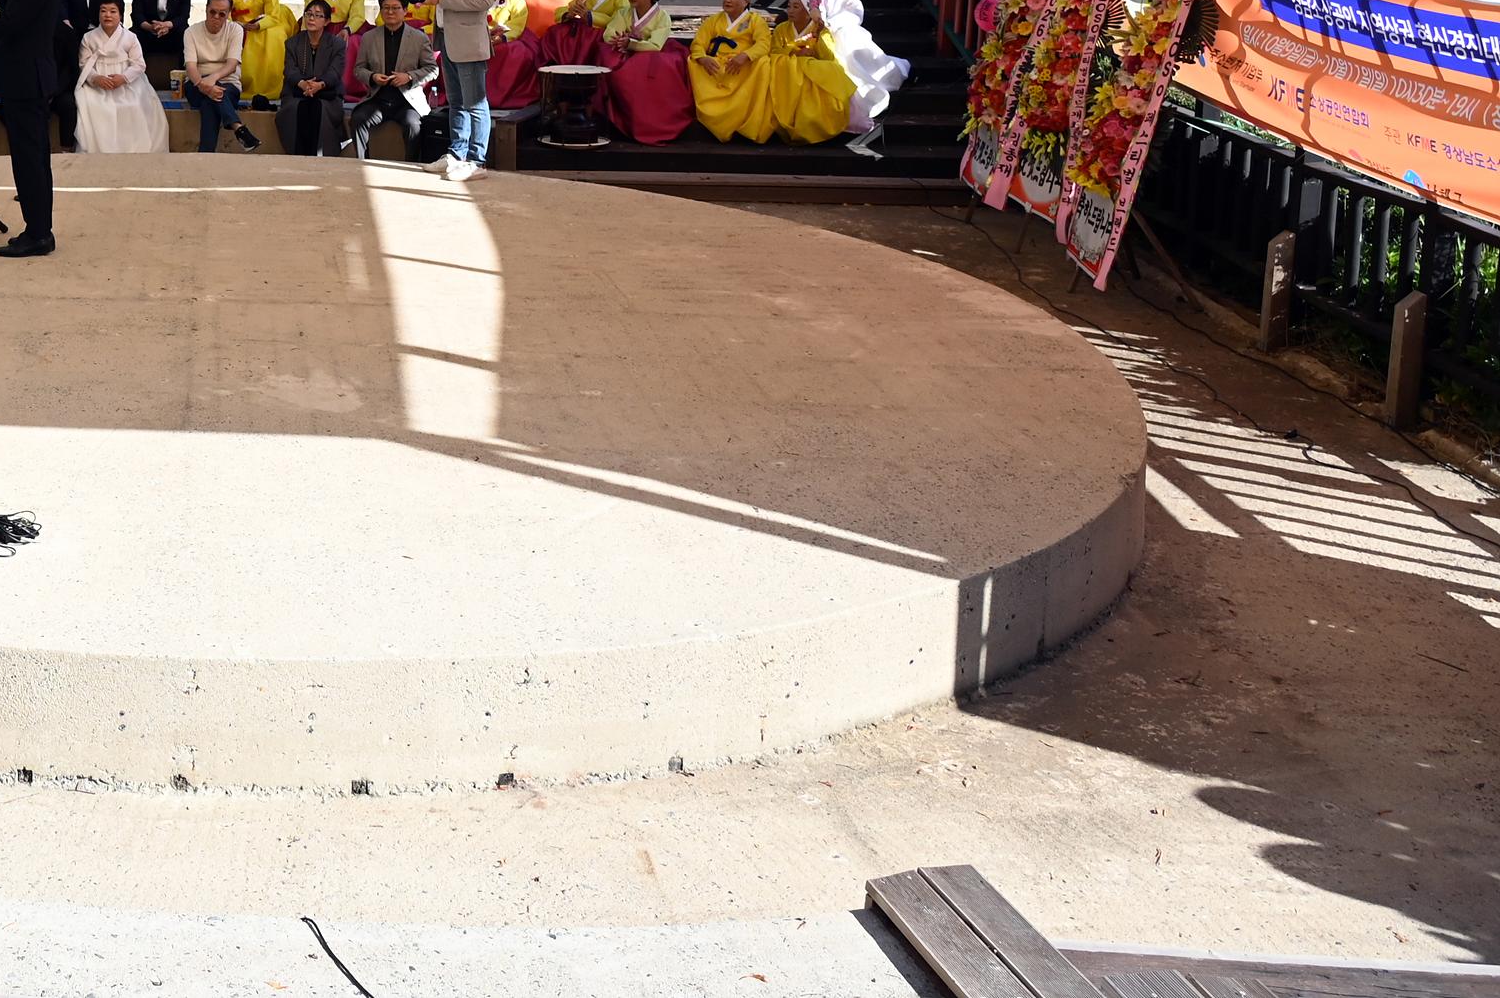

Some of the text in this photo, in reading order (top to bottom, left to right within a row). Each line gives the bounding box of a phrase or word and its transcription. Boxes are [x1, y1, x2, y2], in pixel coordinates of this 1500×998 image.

[1355, 9, 1417, 50] 지역상권
[1156, 22, 1183, 97] LOSO
[1308, 93, 1371, 129] 소상공인연합회
[1406, 132, 1438, 153] KFME
[1441, 142, 1500, 172] 경상남도소
